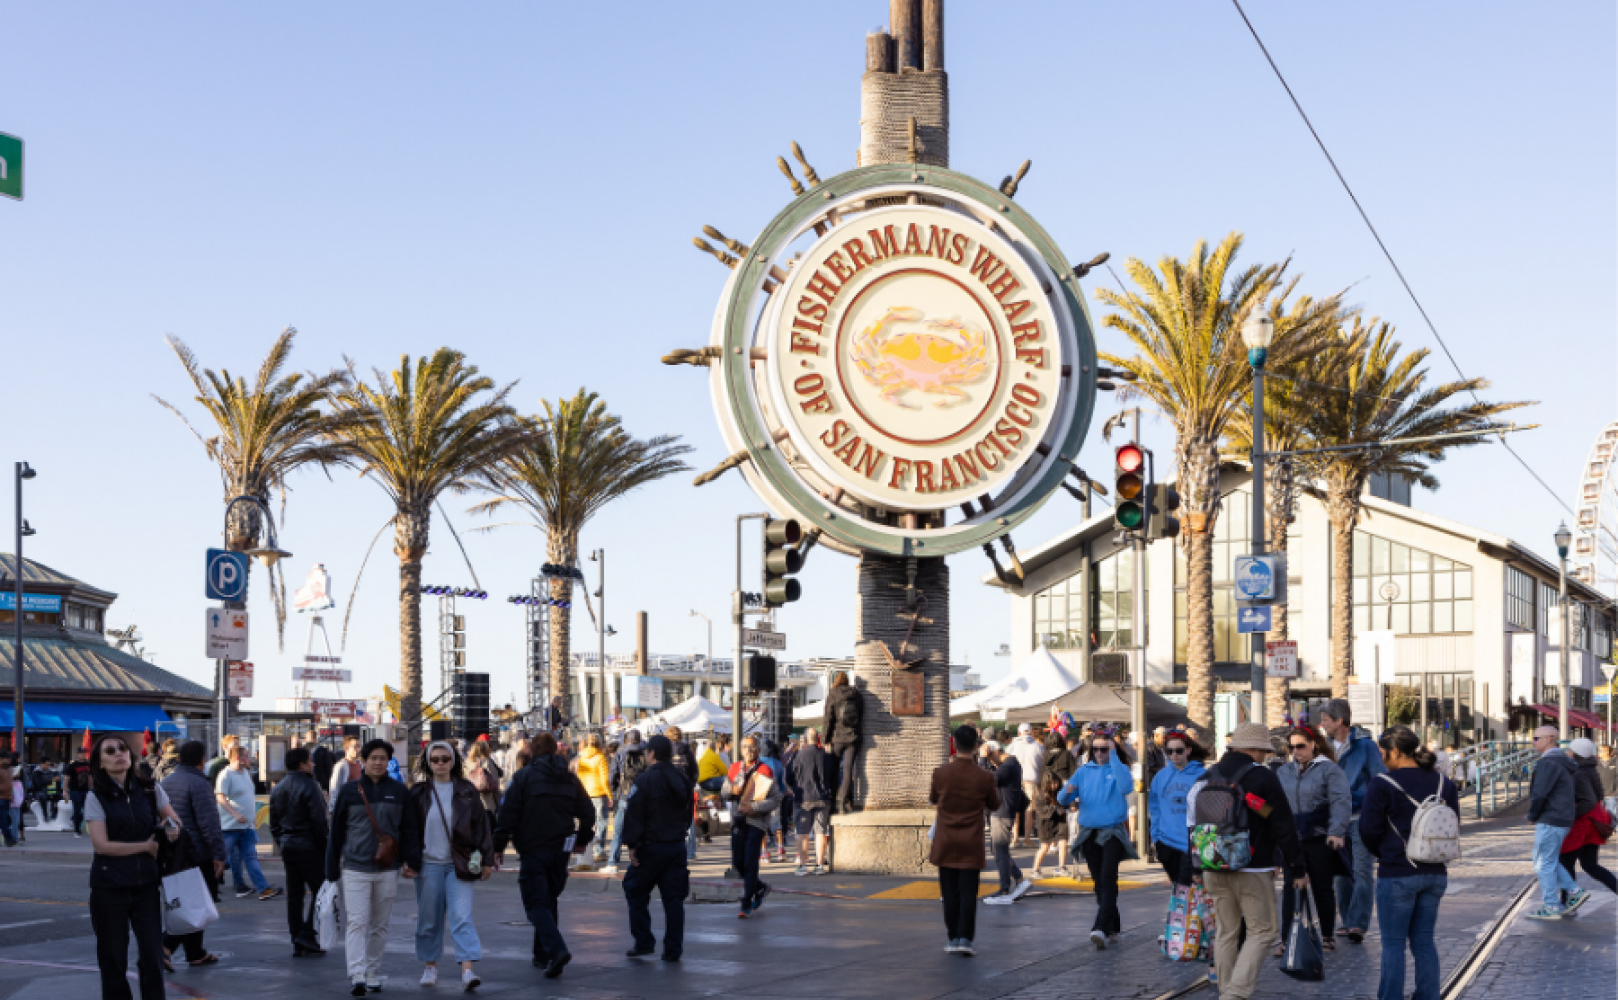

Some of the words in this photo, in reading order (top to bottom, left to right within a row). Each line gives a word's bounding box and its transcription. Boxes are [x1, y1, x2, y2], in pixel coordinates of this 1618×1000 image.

[790, 222, 969, 356] FISHERMANS
[968, 244, 1045, 368] WHARF
[794, 373, 834, 415] OF
[820, 419, 884, 479] SAN
[887, 382, 1041, 493] FRANCISCO
